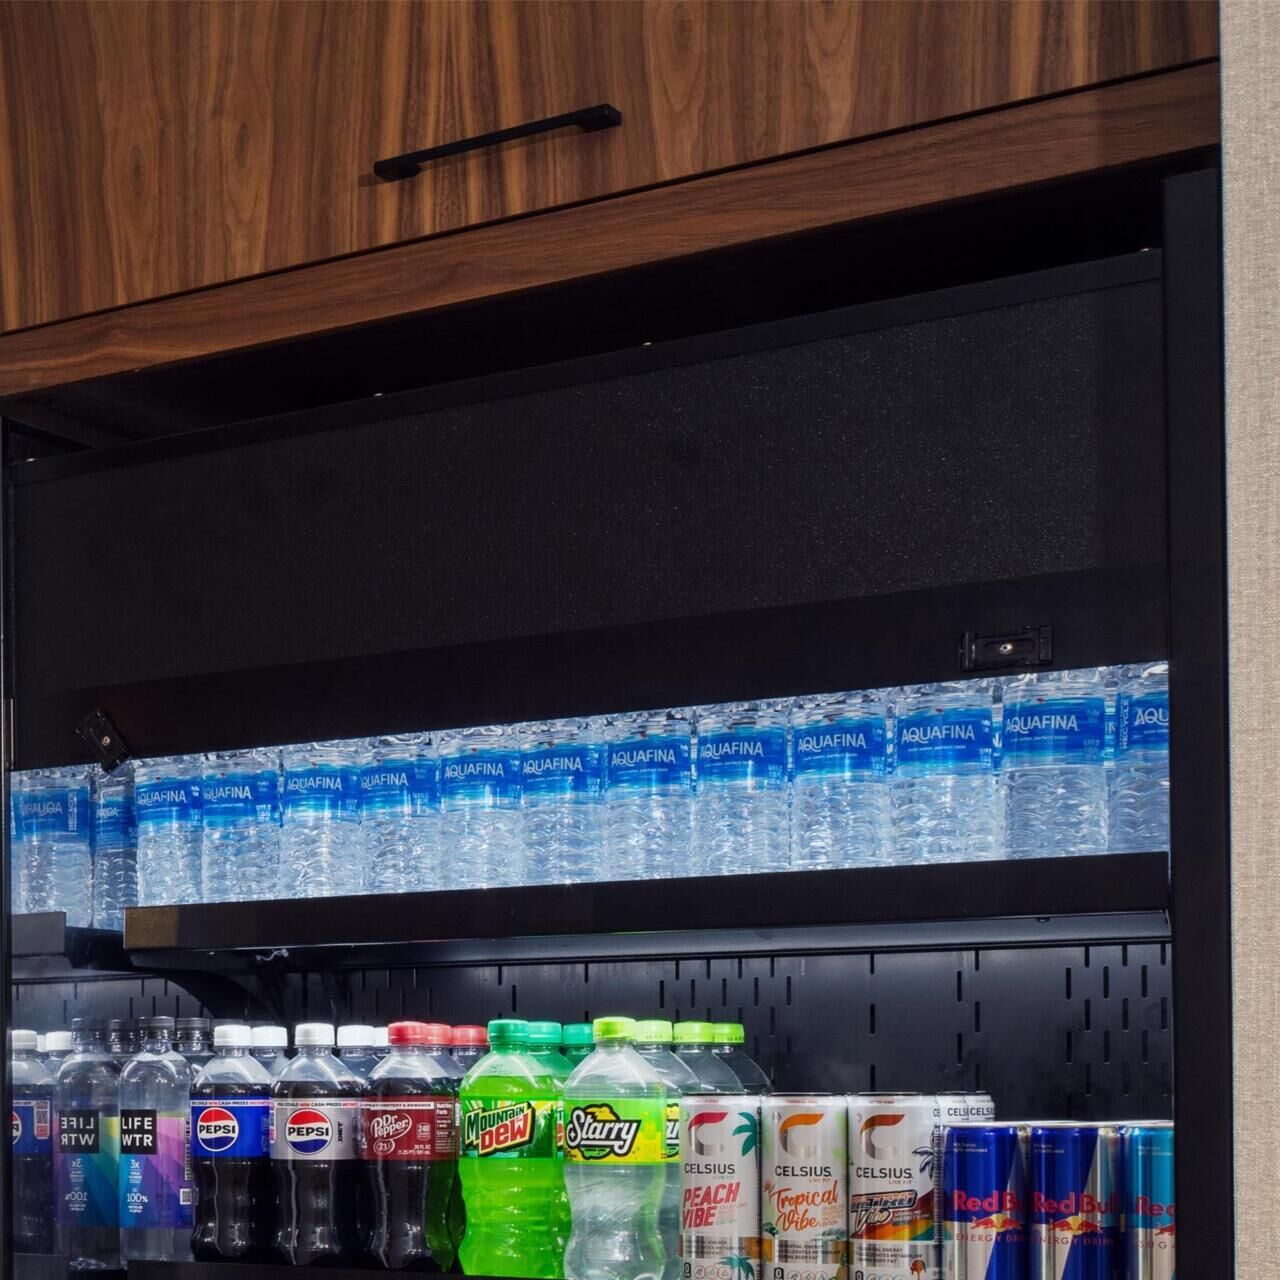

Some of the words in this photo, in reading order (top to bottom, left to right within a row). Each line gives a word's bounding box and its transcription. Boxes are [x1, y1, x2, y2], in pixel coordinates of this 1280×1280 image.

[1005, 714, 1078, 734] AQUAFINA
[901, 724, 975, 745] AQUAFINA
[122, 1117, 153, 1129] LIFE
[199, 1125, 236, 1134] PEPSI
[374, 1118, 408, 1137] Pepper
[568, 1110, 637, 1154] Starry
[122, 1134, 153, 1146] WTR
[684, 1164, 736, 1174] CELSIUS
[775, 1166, 832, 1176] CELSIUS
[684, 1182, 740, 1202] PEACH
[770, 1180, 838, 1214] Tropical
[1032, 1192, 1075, 1213] Red
[1080, 1194, 1120, 1214] Bull
[682, 1206, 717, 1229] VIBE
[776, 1209, 819, 1232] Vibe
